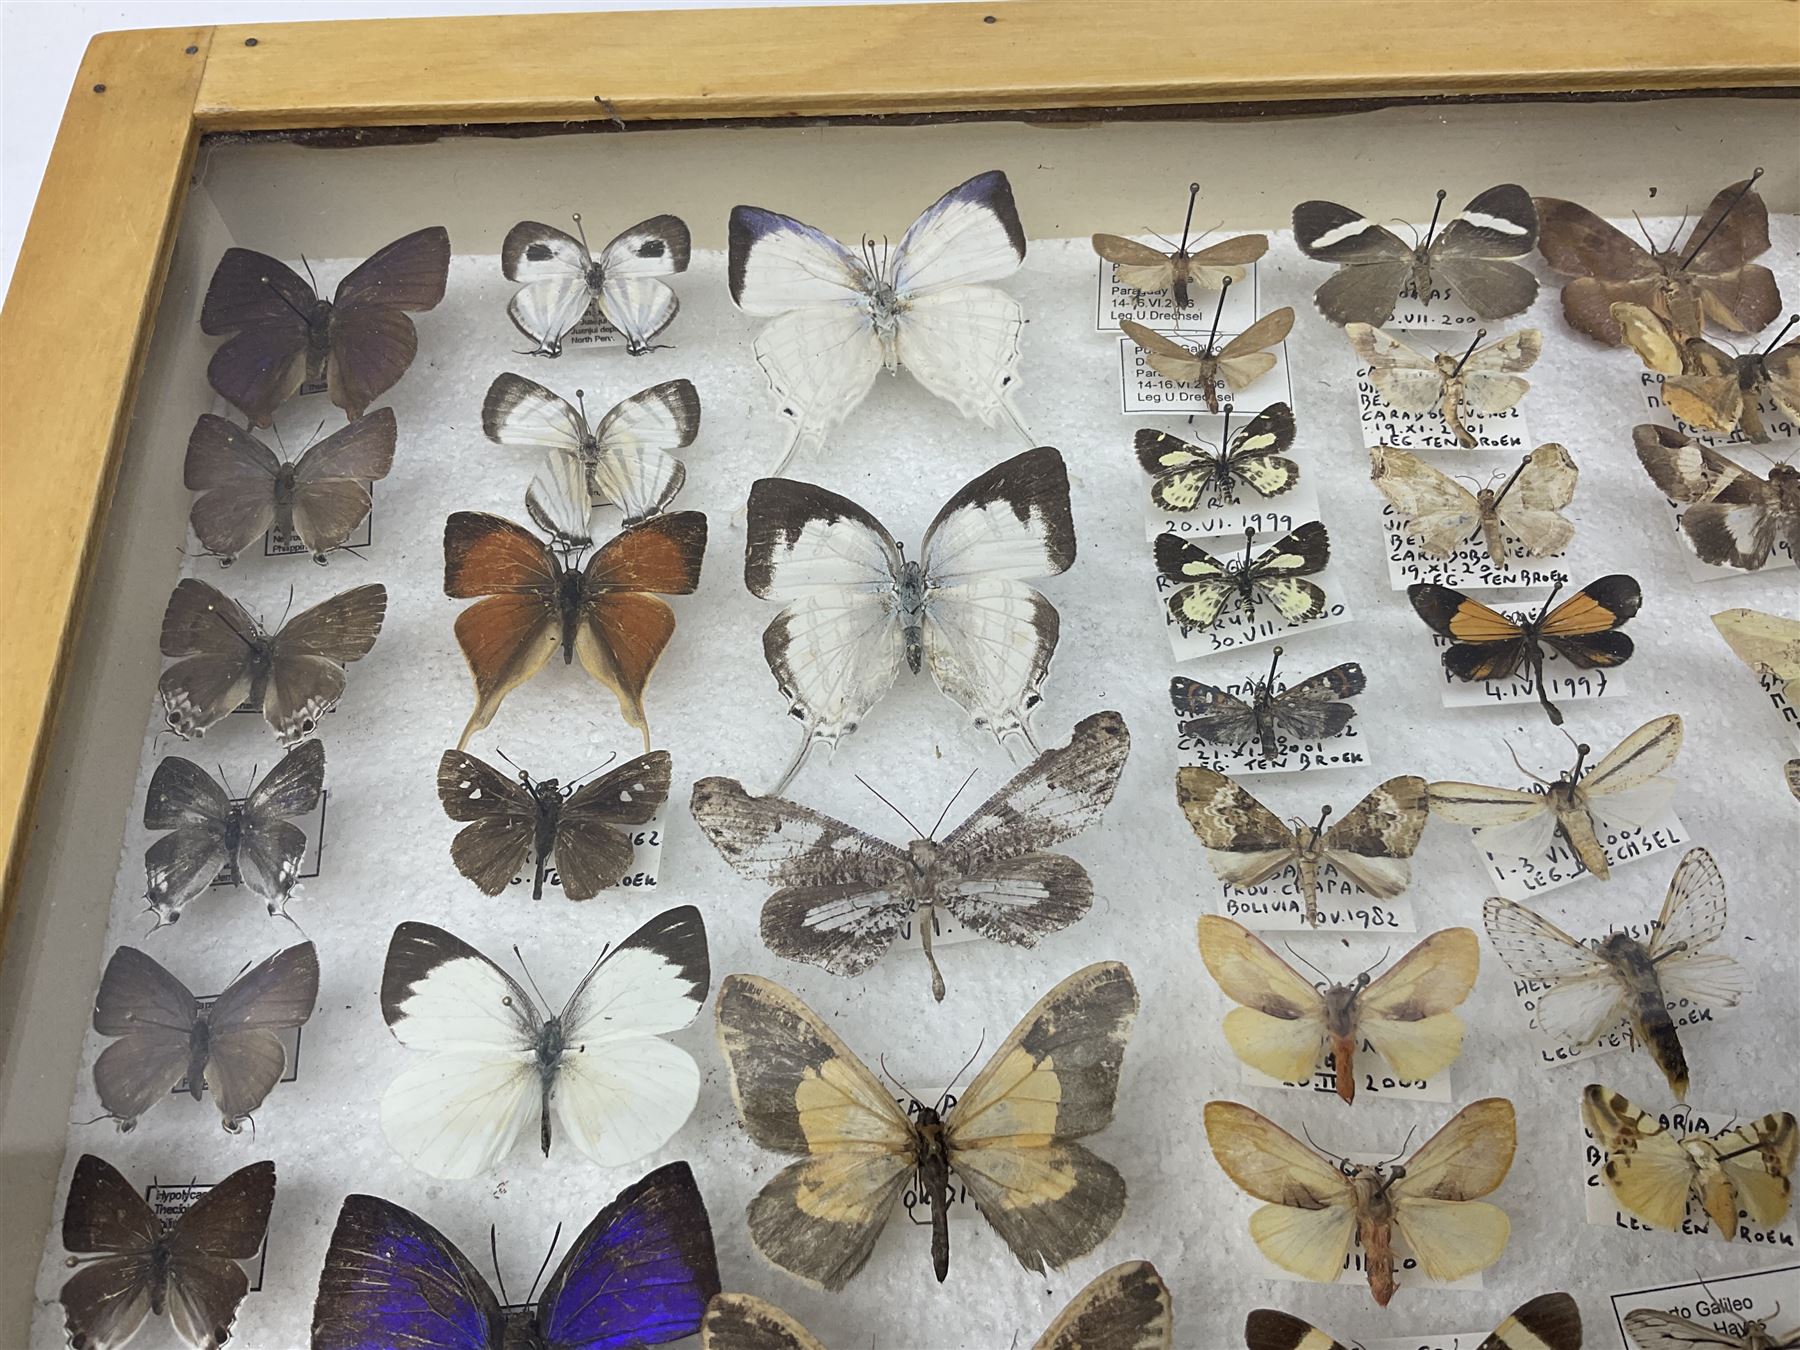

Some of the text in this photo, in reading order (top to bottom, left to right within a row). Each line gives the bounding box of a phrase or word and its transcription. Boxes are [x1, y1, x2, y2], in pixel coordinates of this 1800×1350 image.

[1479, 572, 1517, 584] TEN
[1244, 758, 1288, 771] TEN
[1226, 899, 1300, 916] BOLIVIA
[1696, 1296, 1754, 1318] Galileo
